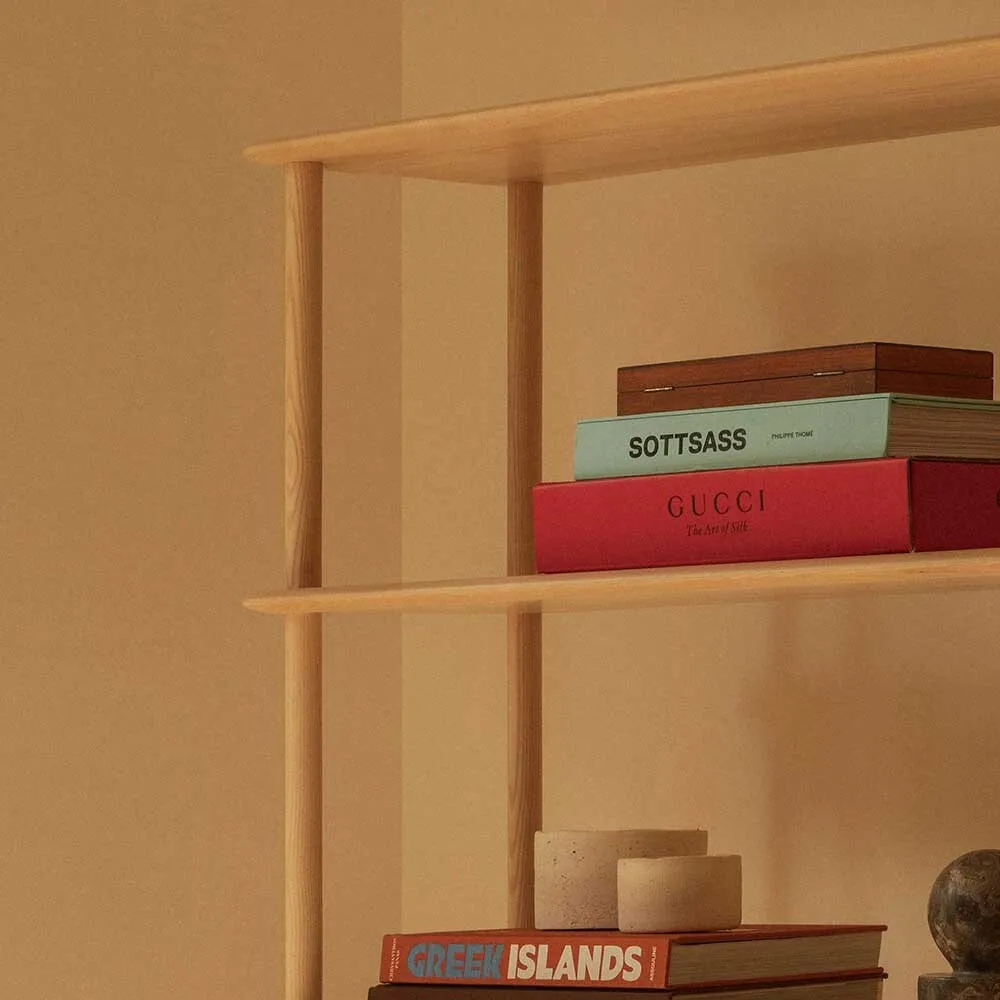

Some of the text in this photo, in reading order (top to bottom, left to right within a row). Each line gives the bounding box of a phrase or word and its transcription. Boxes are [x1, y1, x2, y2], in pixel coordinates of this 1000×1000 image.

[629, 428, 747, 458] SOTTSASS
[668, 490, 765, 518] GUCCI
[687, 520, 748, 536] The Art of Silk
[407, 943, 642, 982] GREEK ISLANDS
